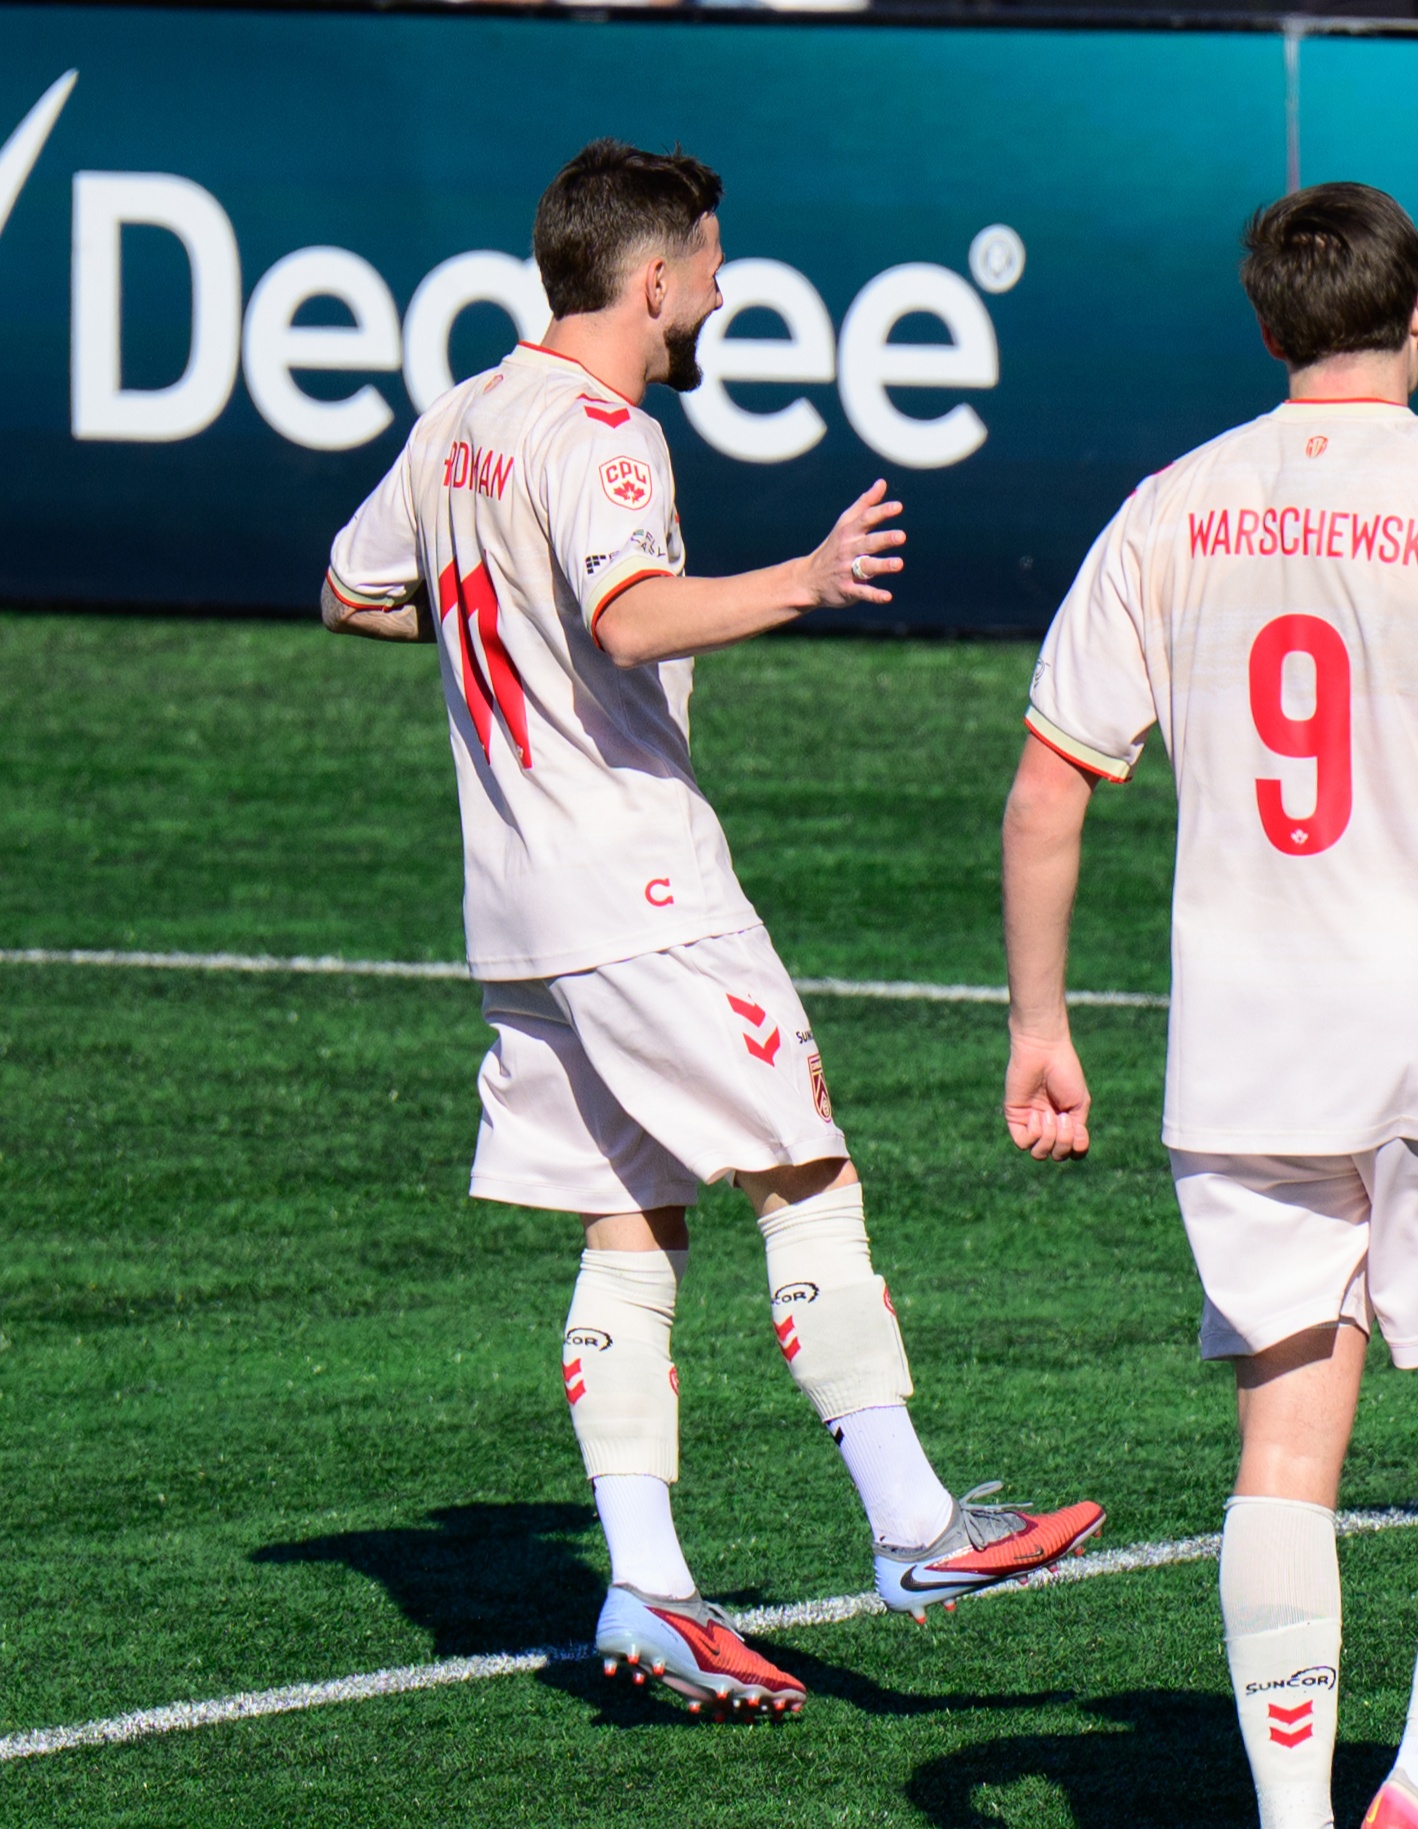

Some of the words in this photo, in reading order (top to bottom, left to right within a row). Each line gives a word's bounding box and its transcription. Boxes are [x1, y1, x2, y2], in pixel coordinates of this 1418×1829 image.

[605, 461, 647, 485] CPL
[438, 549, 533, 770] 11
[1248, 613, 1353, 856] 9
[644, 878, 675, 907] C
[1245, 1674, 1329, 1696] SUNCOR
